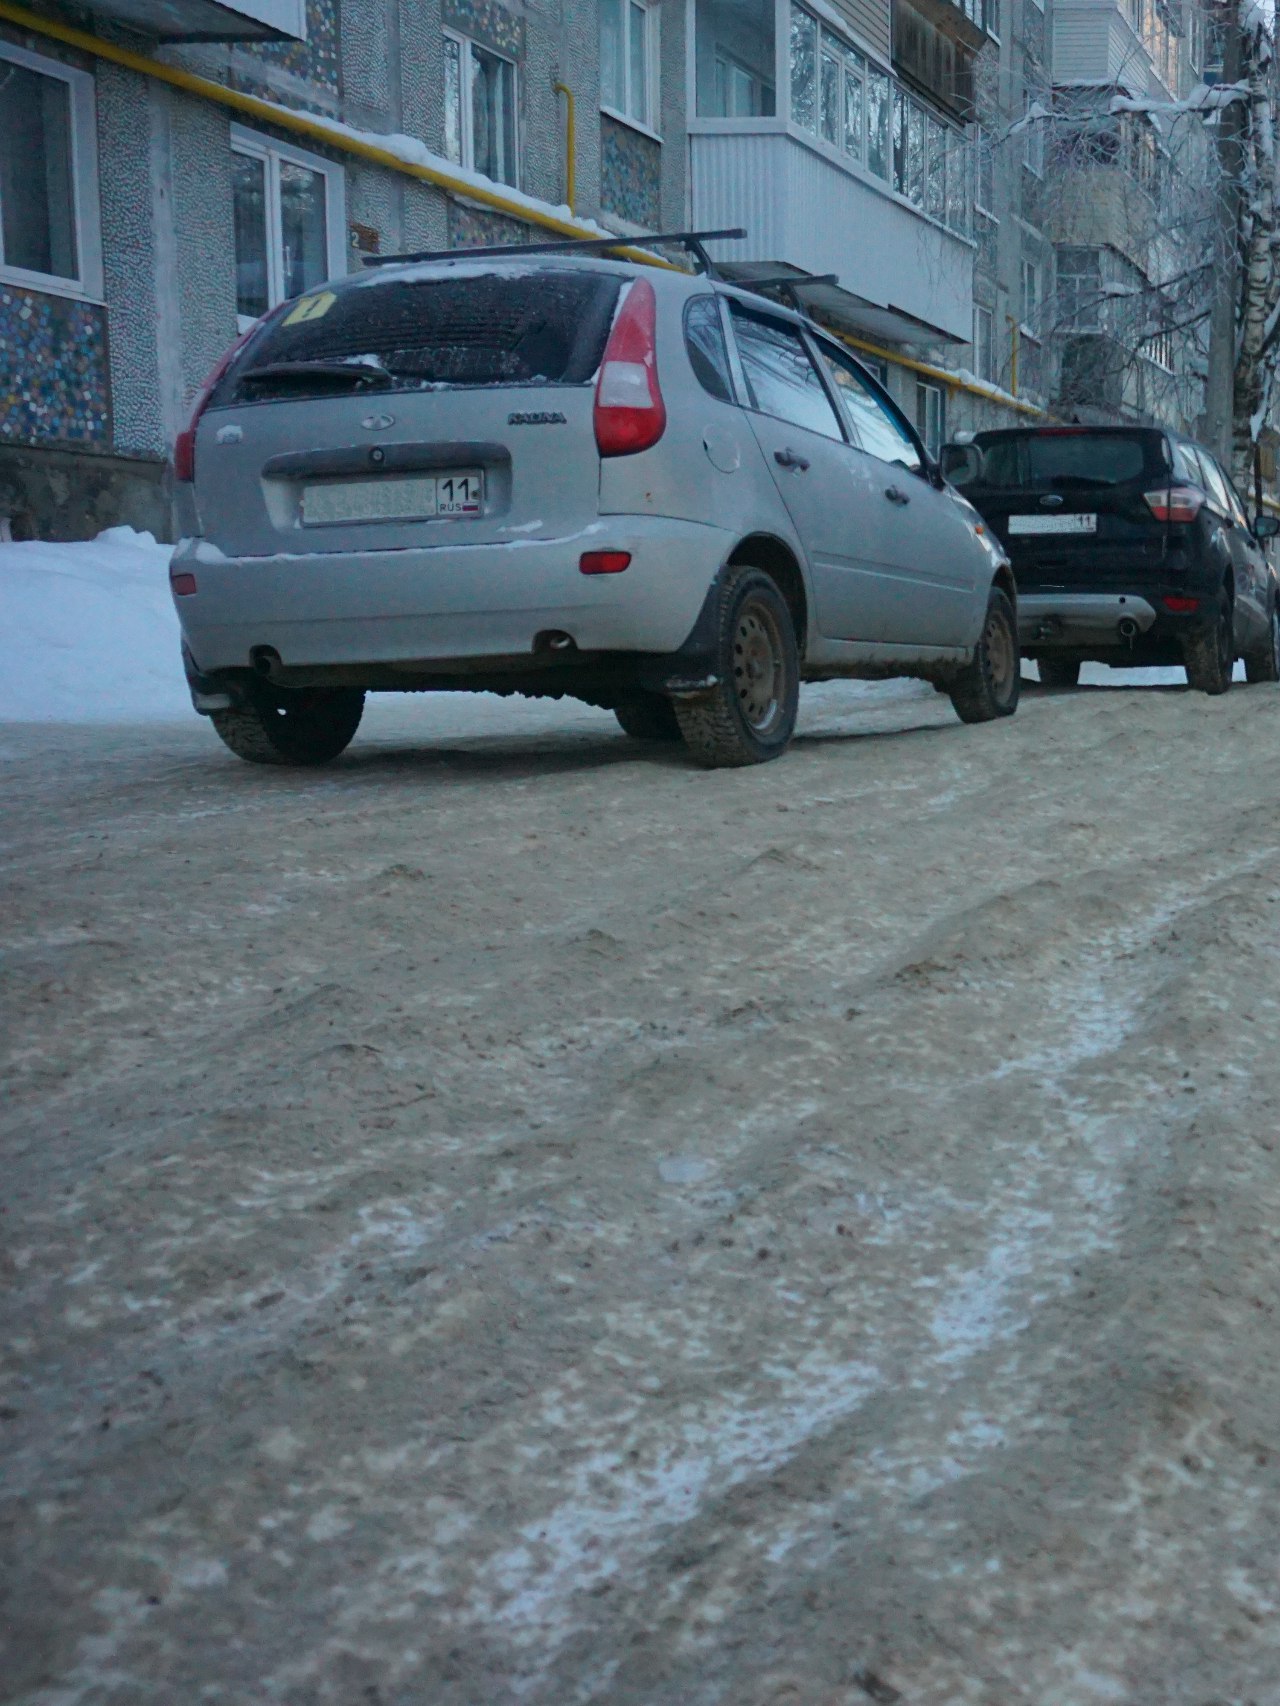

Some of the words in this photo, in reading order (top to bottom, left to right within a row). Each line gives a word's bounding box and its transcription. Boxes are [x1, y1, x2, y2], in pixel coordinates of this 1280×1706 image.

[351, 231, 360, 248] 2
[442, 478, 469, 502] 11
[440, 503, 462, 512] RUS
